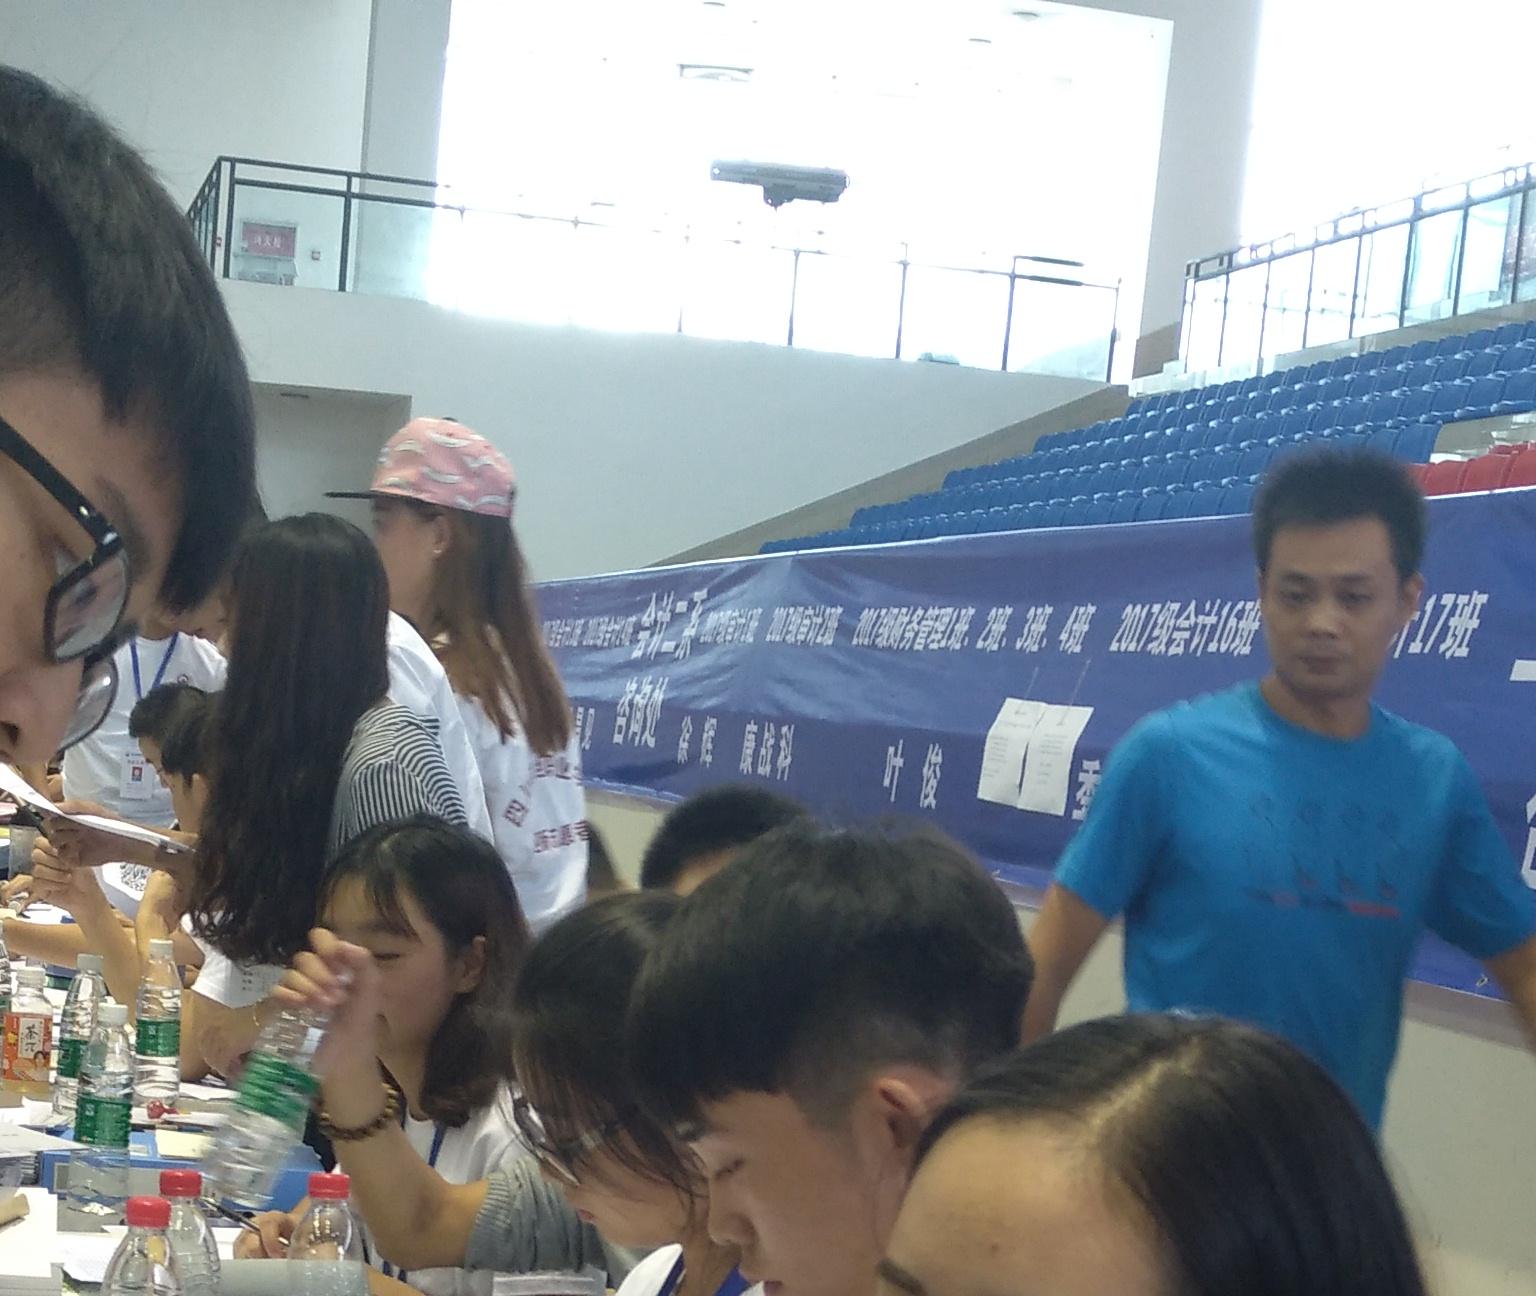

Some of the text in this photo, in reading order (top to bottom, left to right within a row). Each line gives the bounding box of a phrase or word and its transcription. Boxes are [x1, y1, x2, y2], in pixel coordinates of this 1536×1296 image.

[630, 588, 708, 661] 会计二系
[765, 605, 844, 646] 2017级审计2班
[613, 676, 669, 748] 咨询处
